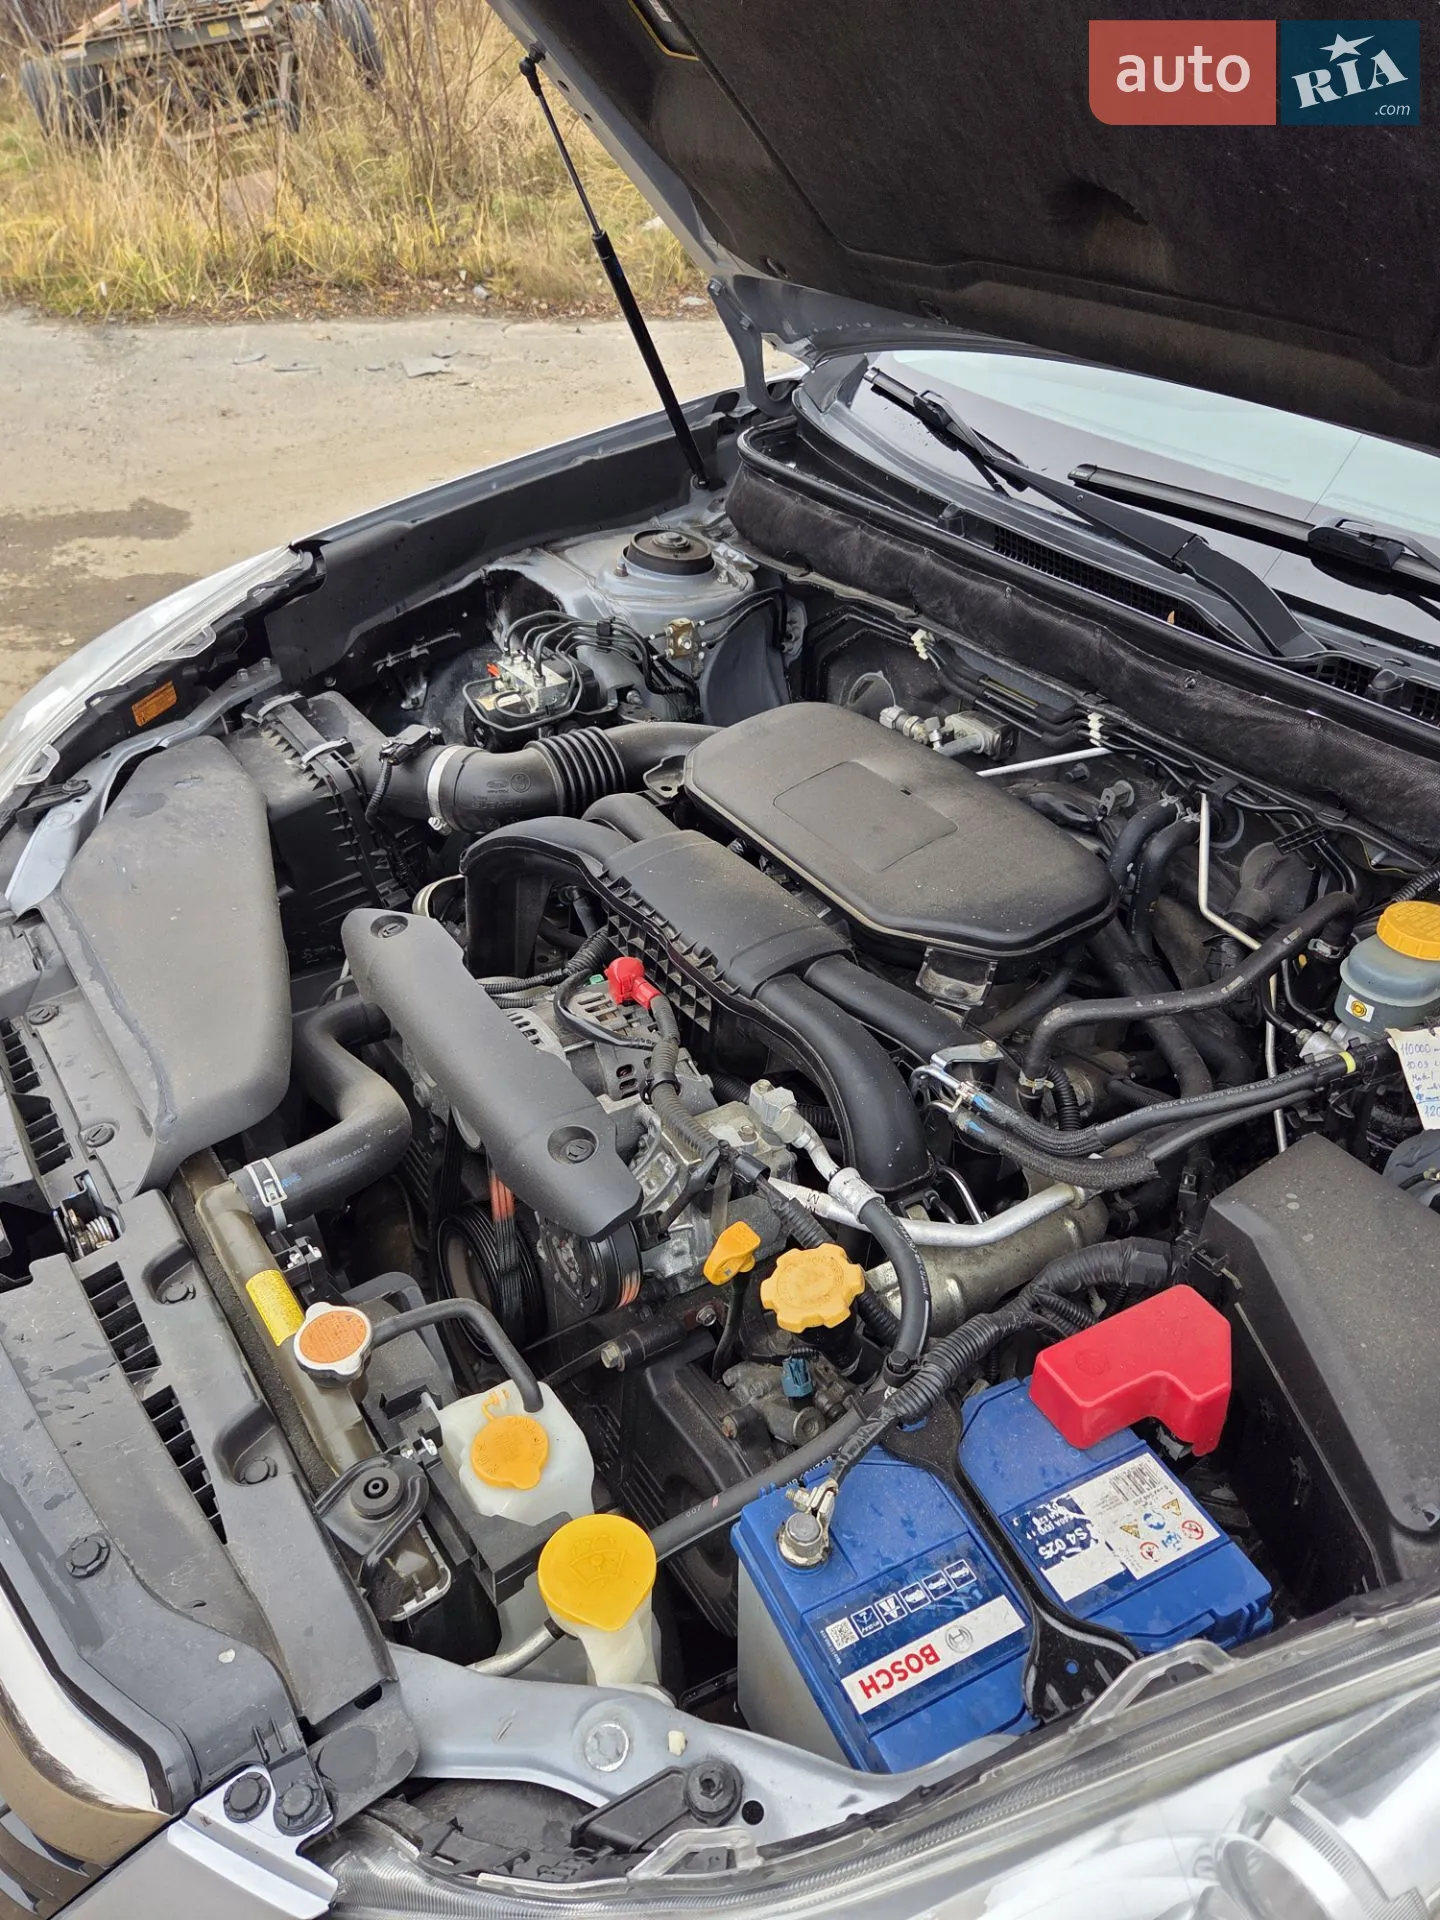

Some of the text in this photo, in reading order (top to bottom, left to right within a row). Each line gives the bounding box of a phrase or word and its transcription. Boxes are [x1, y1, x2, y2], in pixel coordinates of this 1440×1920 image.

[1038, 1527, 1088, 1560] S4 025
[858, 1644, 940, 1699] BOSCH
